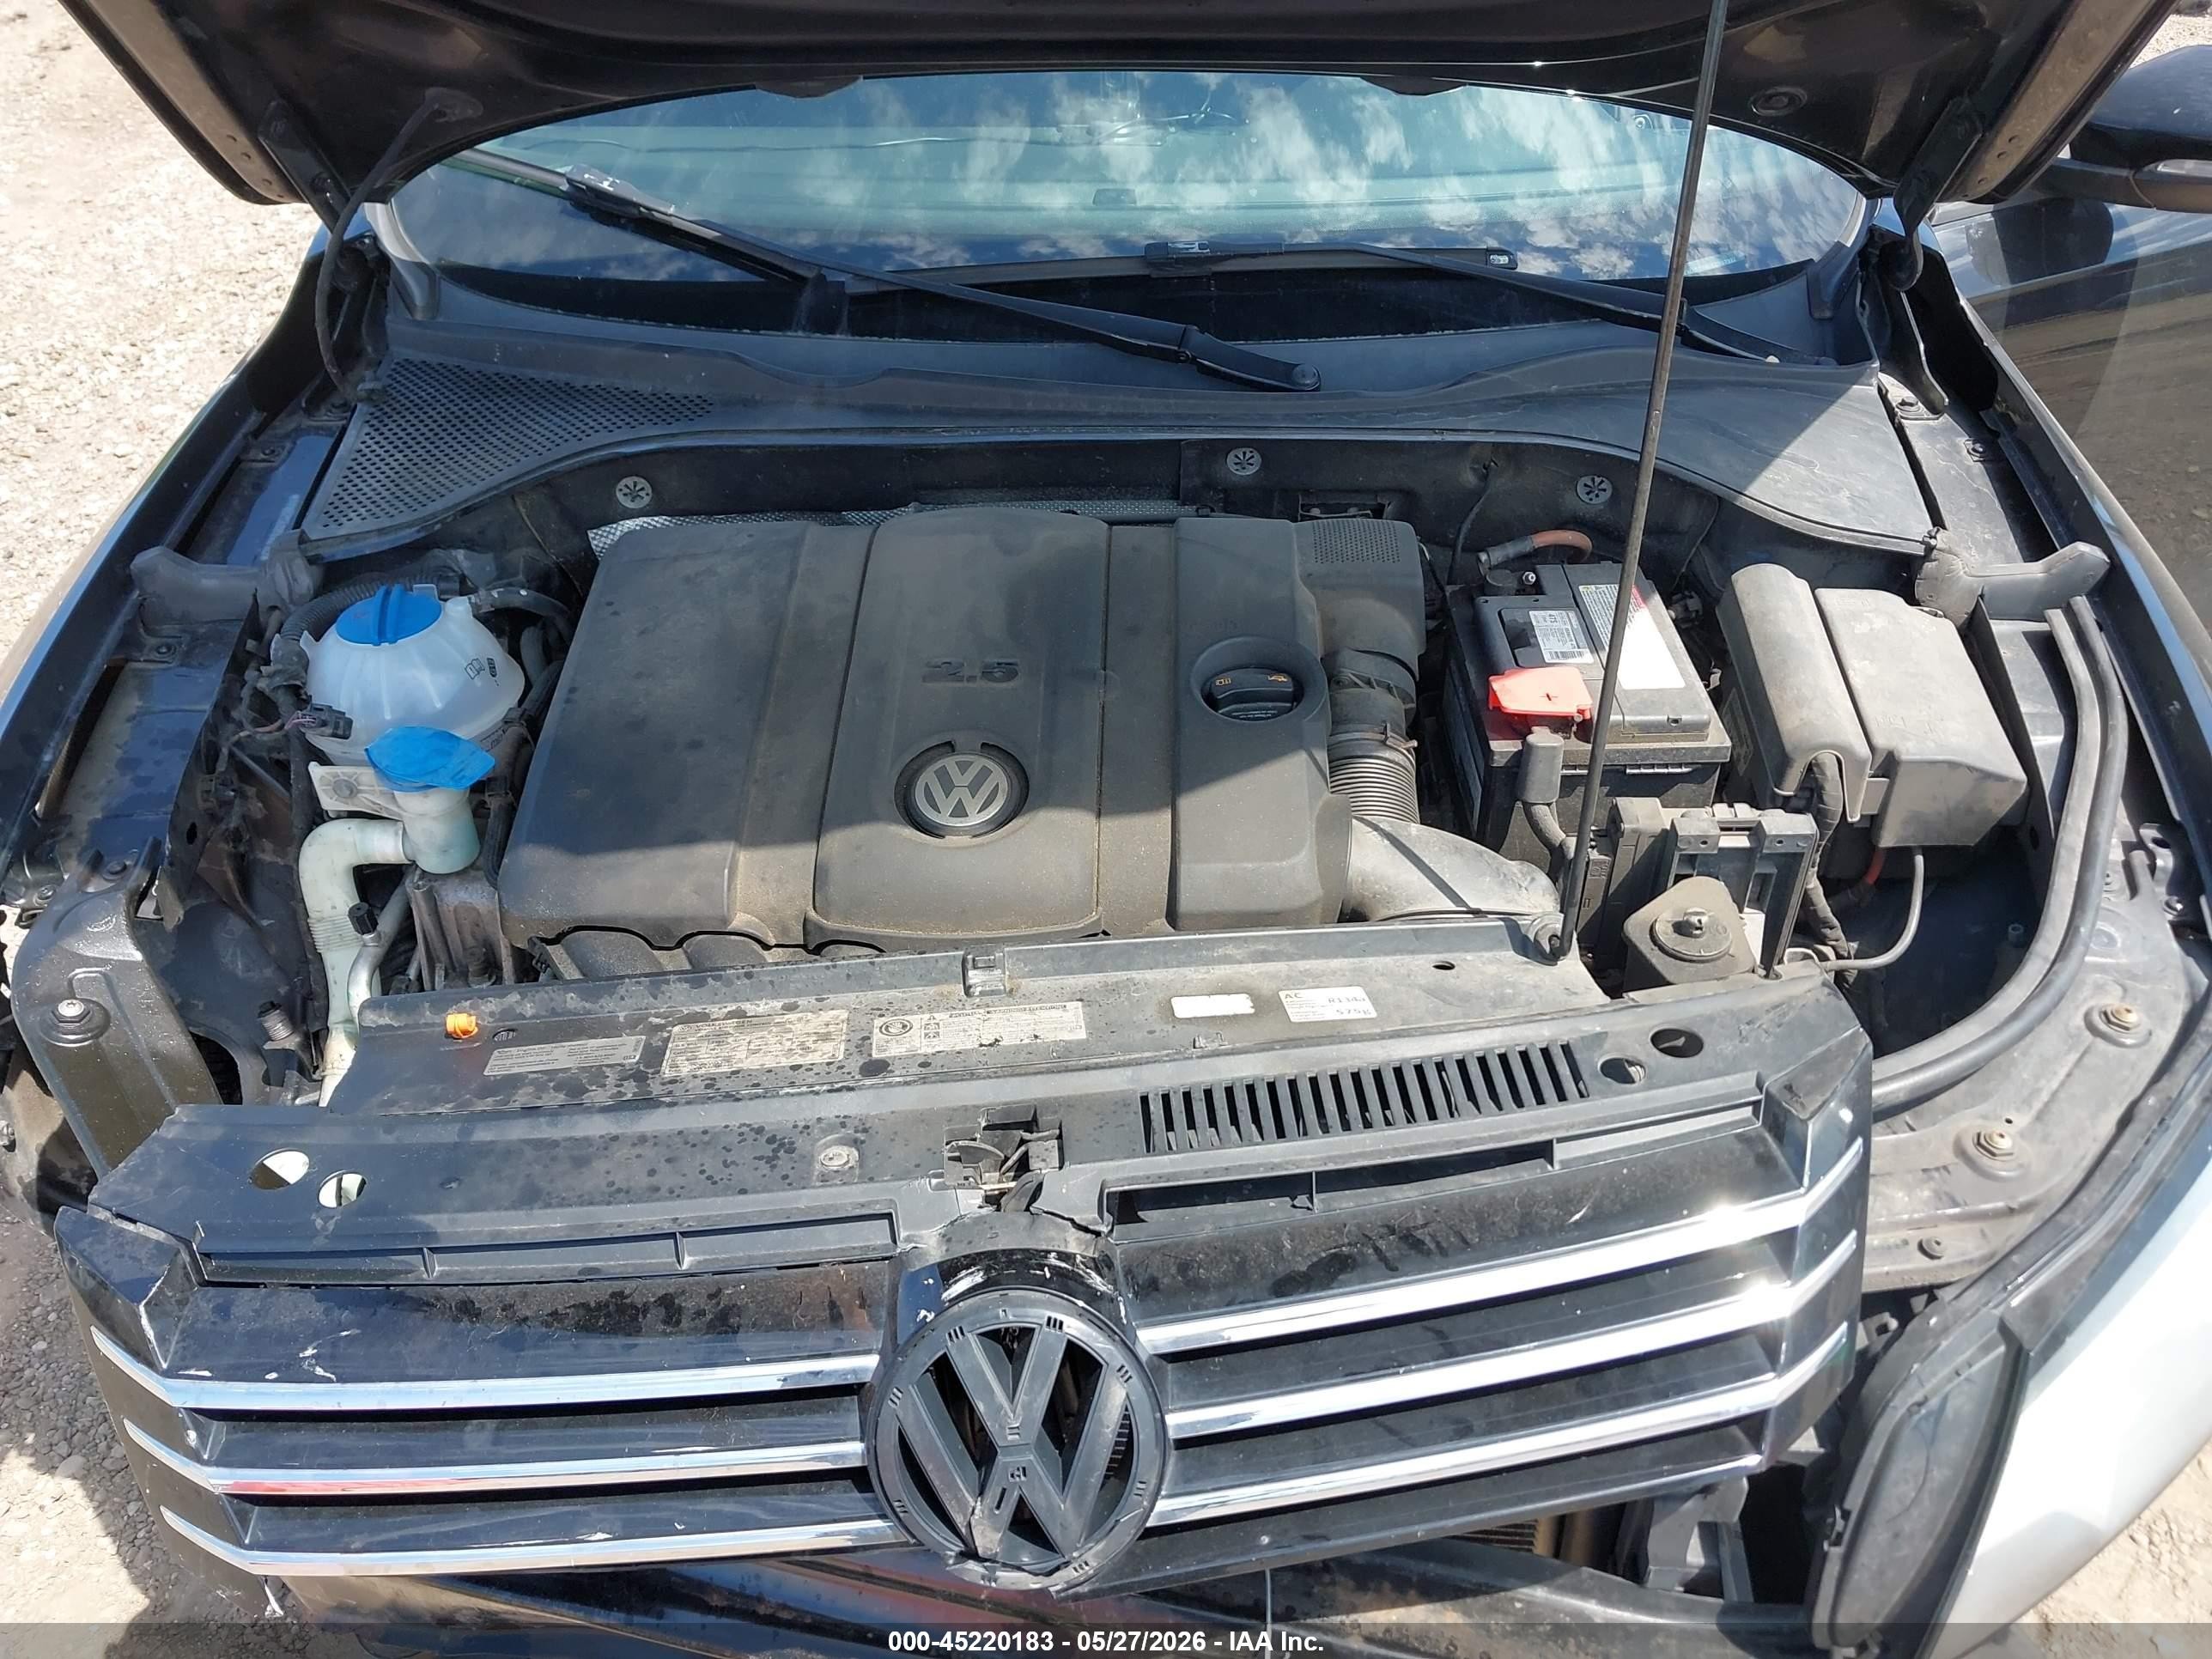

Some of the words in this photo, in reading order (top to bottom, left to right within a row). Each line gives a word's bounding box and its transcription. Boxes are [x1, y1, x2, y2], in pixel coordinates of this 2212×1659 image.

[921, 659, 1019, 684] 2.5
[915, 755, 1008, 826] VW
[872, 1292, 1161, 1578] VW
